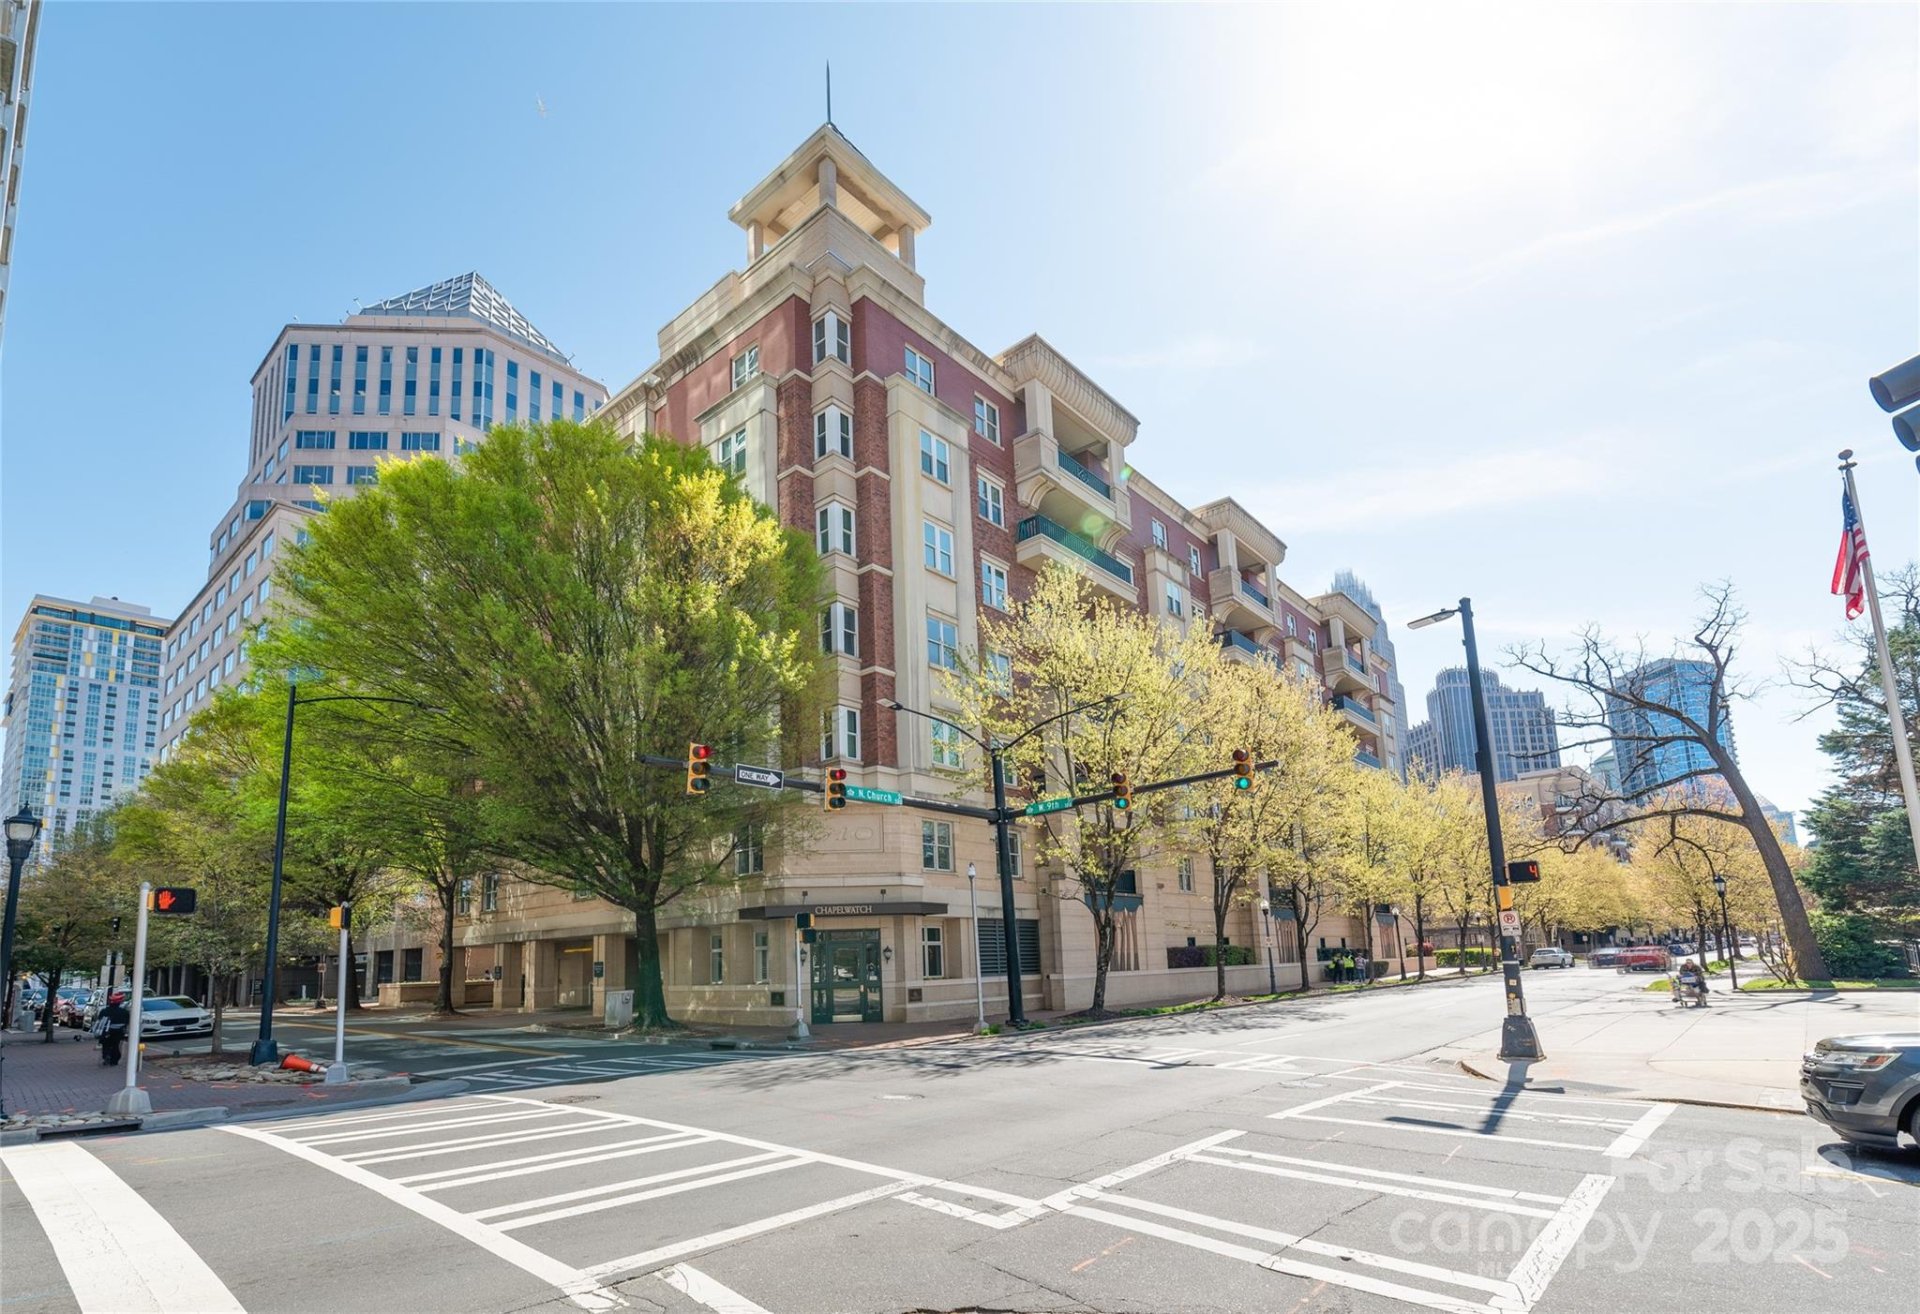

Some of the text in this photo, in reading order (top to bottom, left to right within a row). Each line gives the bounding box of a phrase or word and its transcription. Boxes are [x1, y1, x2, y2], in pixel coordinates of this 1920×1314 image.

[741, 770, 770, 782] ONE WAY
[866, 790, 892, 803] Church
[1046, 802, 1060, 810] 9th
[1530, 865, 1538, 878] 4
[815, 905, 872, 914] CHAPELWATCH
